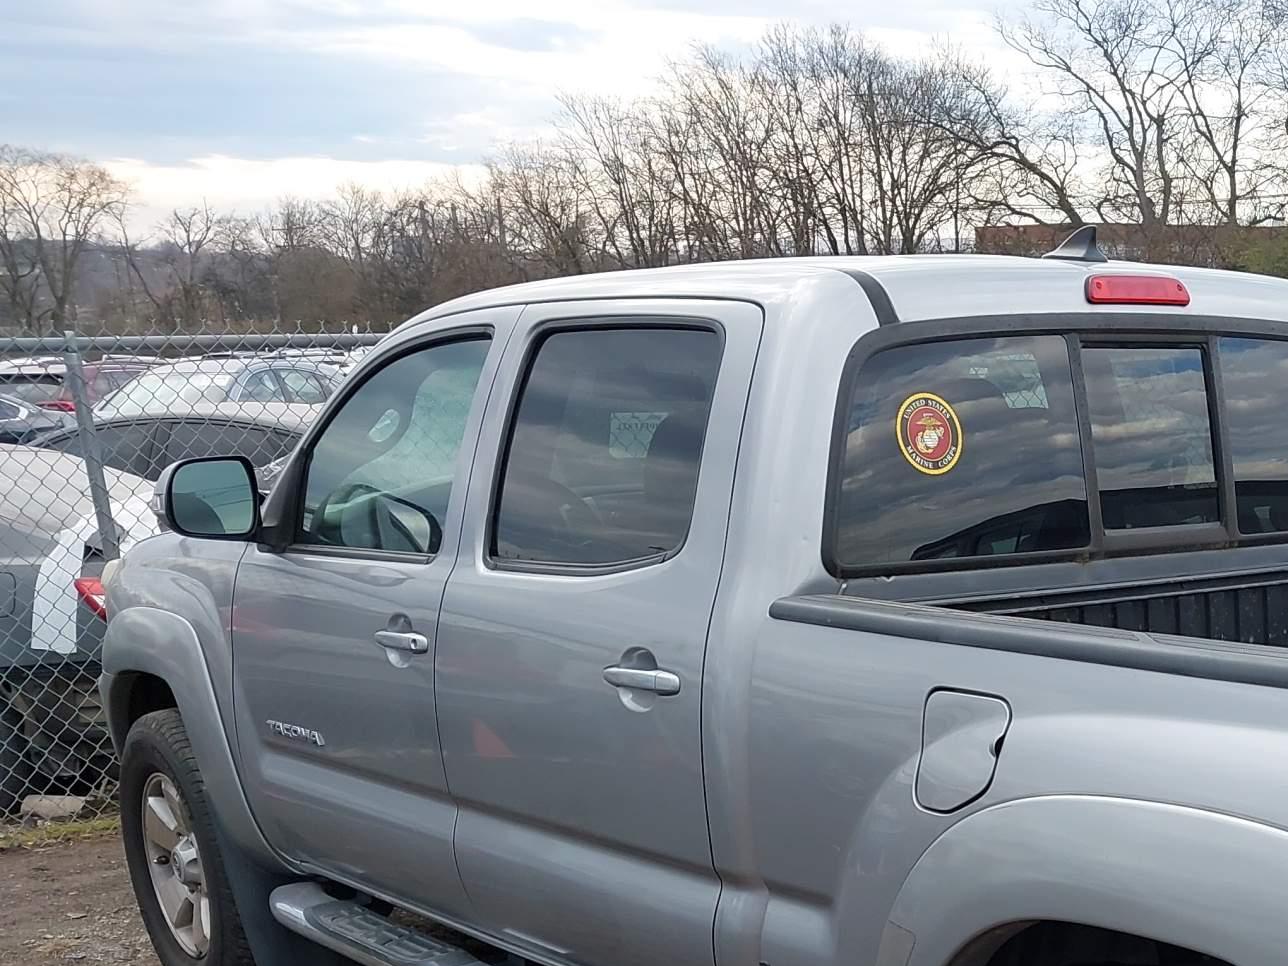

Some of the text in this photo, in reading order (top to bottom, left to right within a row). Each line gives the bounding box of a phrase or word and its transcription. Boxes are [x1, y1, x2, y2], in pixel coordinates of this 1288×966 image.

[903, 399, 951, 419] UNITED STATES
[906, 445, 957, 468] MARINE CORPS
[265, 719, 325, 746] TACOMA
